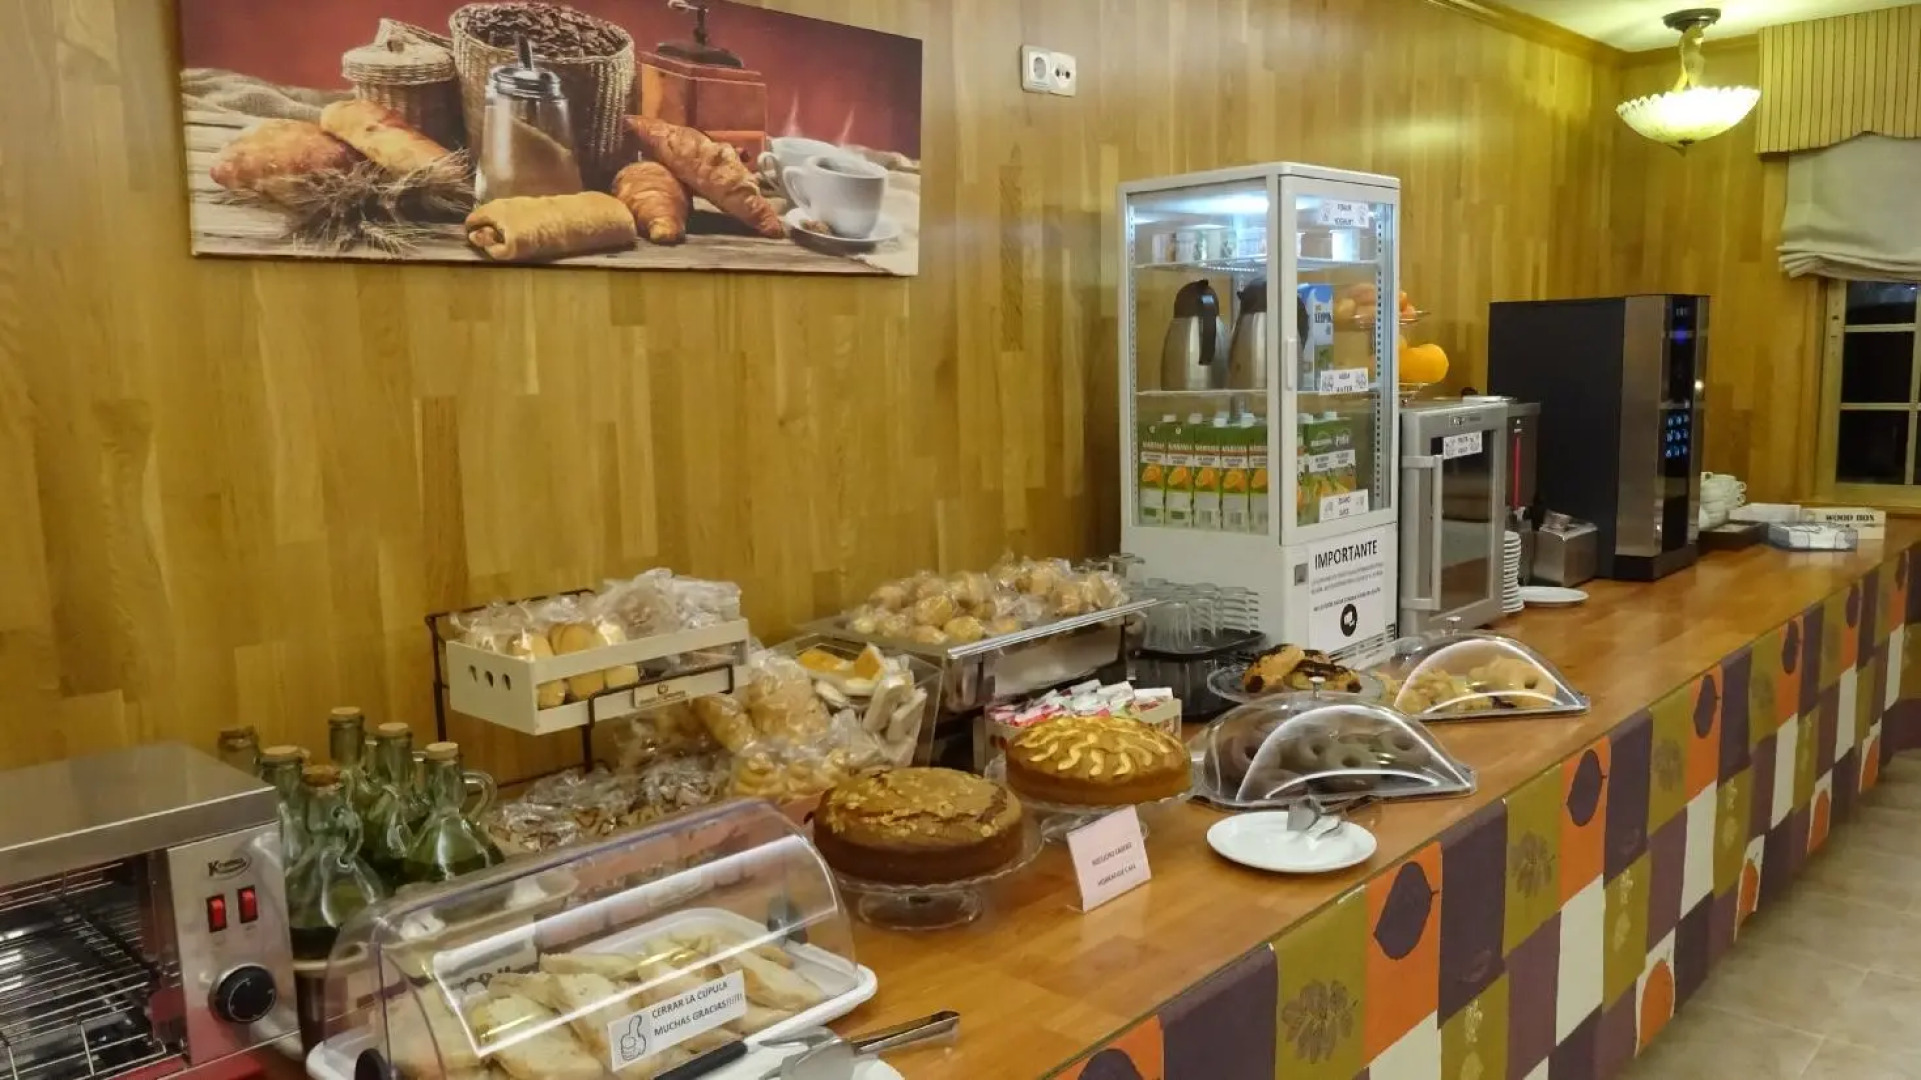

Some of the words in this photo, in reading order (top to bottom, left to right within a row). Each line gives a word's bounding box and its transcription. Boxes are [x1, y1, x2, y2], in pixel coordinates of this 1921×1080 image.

[1825, 514, 1854, 522] WOOD
[1856, 514, 1874, 522] BOX
[1314, 539, 1378, 571] IMPORTANTE
[652, 999, 685, 1018] CERRAR
[686, 992, 696, 1004] LA
[654, 1016, 691, 1036] MUCHAS
